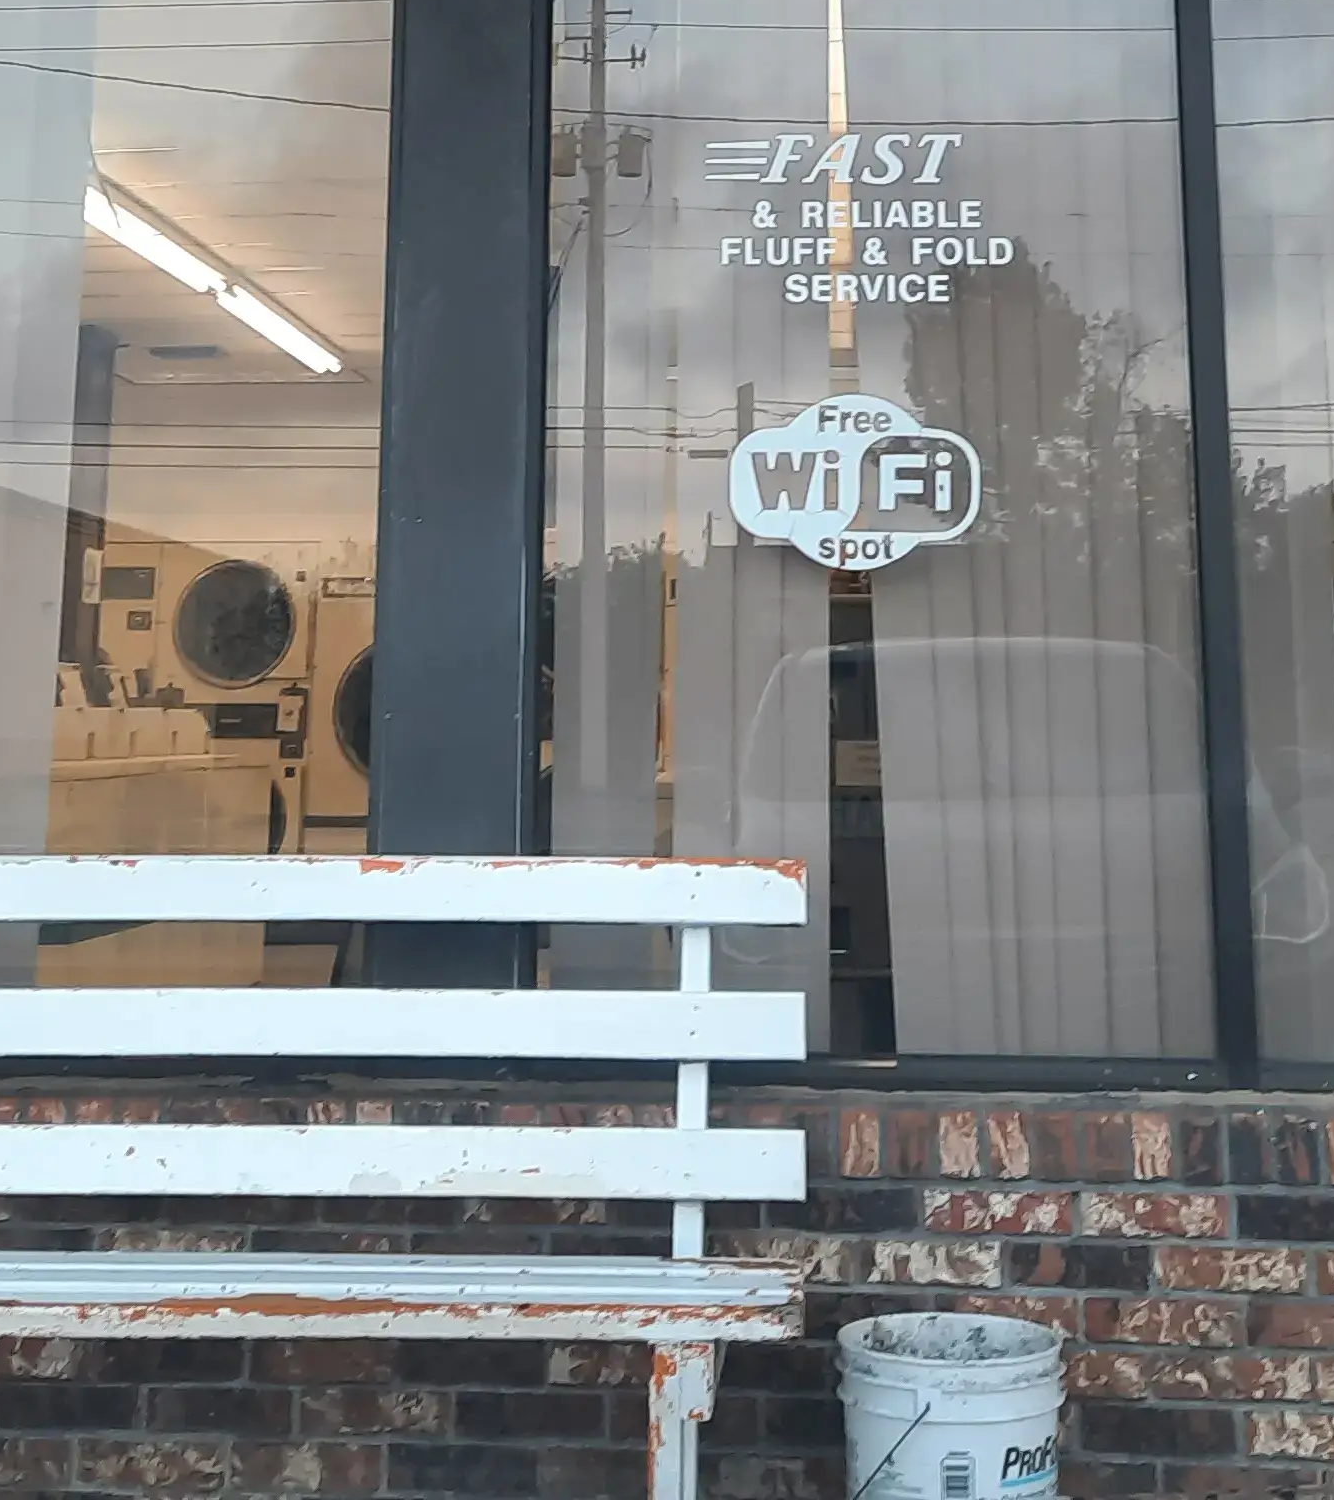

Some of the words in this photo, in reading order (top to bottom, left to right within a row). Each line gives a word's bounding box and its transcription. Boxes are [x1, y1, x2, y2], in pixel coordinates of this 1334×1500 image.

[758, 133, 963, 185] FAST
[752, 200, 778, 229] &
[801, 200, 983, 229] RELIABLE
[720, 236, 838, 266] FLUFF
[862, 237, 888, 266] &
[912, 237, 1015, 266] FOLD
[783, 274, 951, 303] SERVICE
[818, 404, 893, 433] Free
[818, 534, 895, 567] spot
